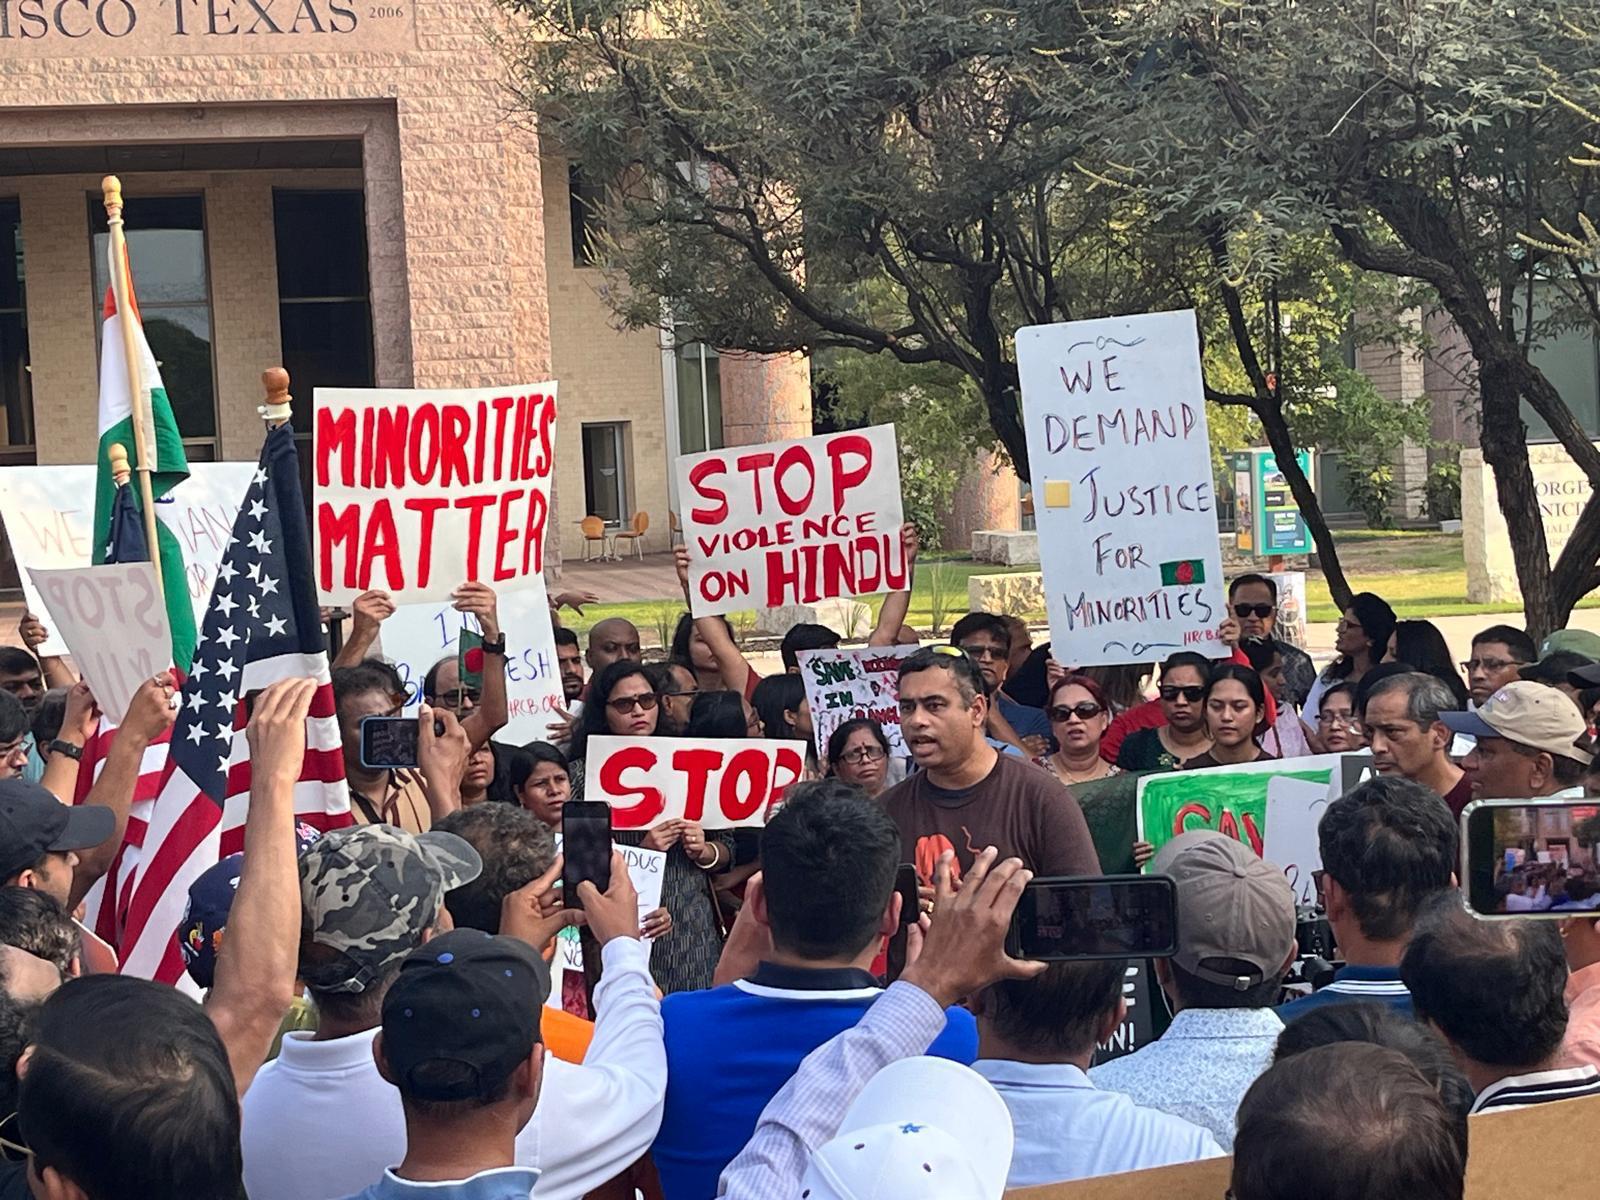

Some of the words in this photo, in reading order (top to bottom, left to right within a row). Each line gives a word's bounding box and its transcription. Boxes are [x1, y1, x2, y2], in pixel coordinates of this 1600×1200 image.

[158, 0, 358, 35] TEXAS
[369, 7, 404, 19] 2006
[1060, 355, 1125, 394] WE
[316, 394, 556, 489] MINORITIES
[1043, 403, 1197, 454] DEMAND
[689, 435, 872, 525] STOP
[1080, 467, 1212, 522] JUSTICE
[20, 509, 89, 557] WE
[318, 488, 548, 592] MATTER
[698, 512, 877, 557] VIOLENCE
[1092, 532, 1151, 576] FOR
[700, 569, 749, 602] ON
[765, 529, 906, 608] HINDU
[1064, 586, 1213, 631] MINORITIES
[825, 691, 854, 709] IN
[600, 747, 802, 829] STOP
